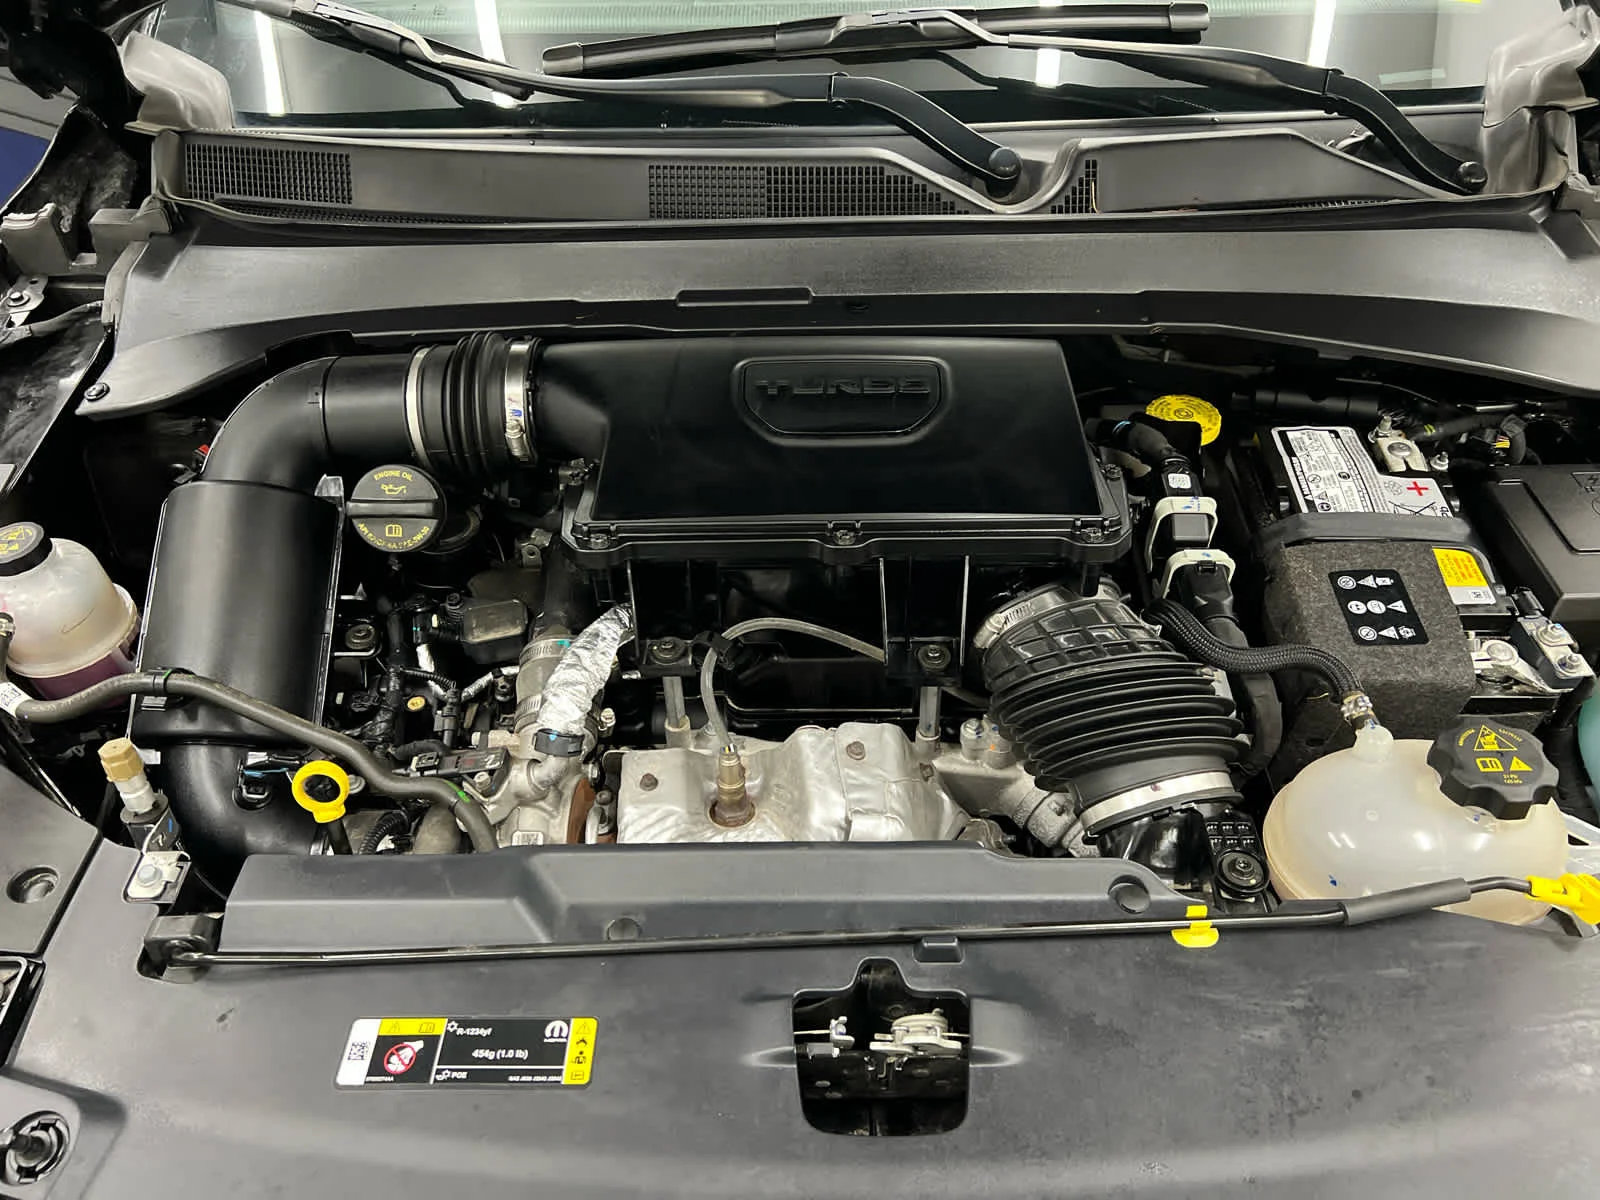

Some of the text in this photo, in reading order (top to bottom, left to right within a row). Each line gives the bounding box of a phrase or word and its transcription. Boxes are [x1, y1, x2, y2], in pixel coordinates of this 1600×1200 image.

[755, 376, 931, 395] TURBO
[373, 470, 413, 481] ENGINE OIL
[471, 1049, 529, 1060] 454g (1.0 lb)
